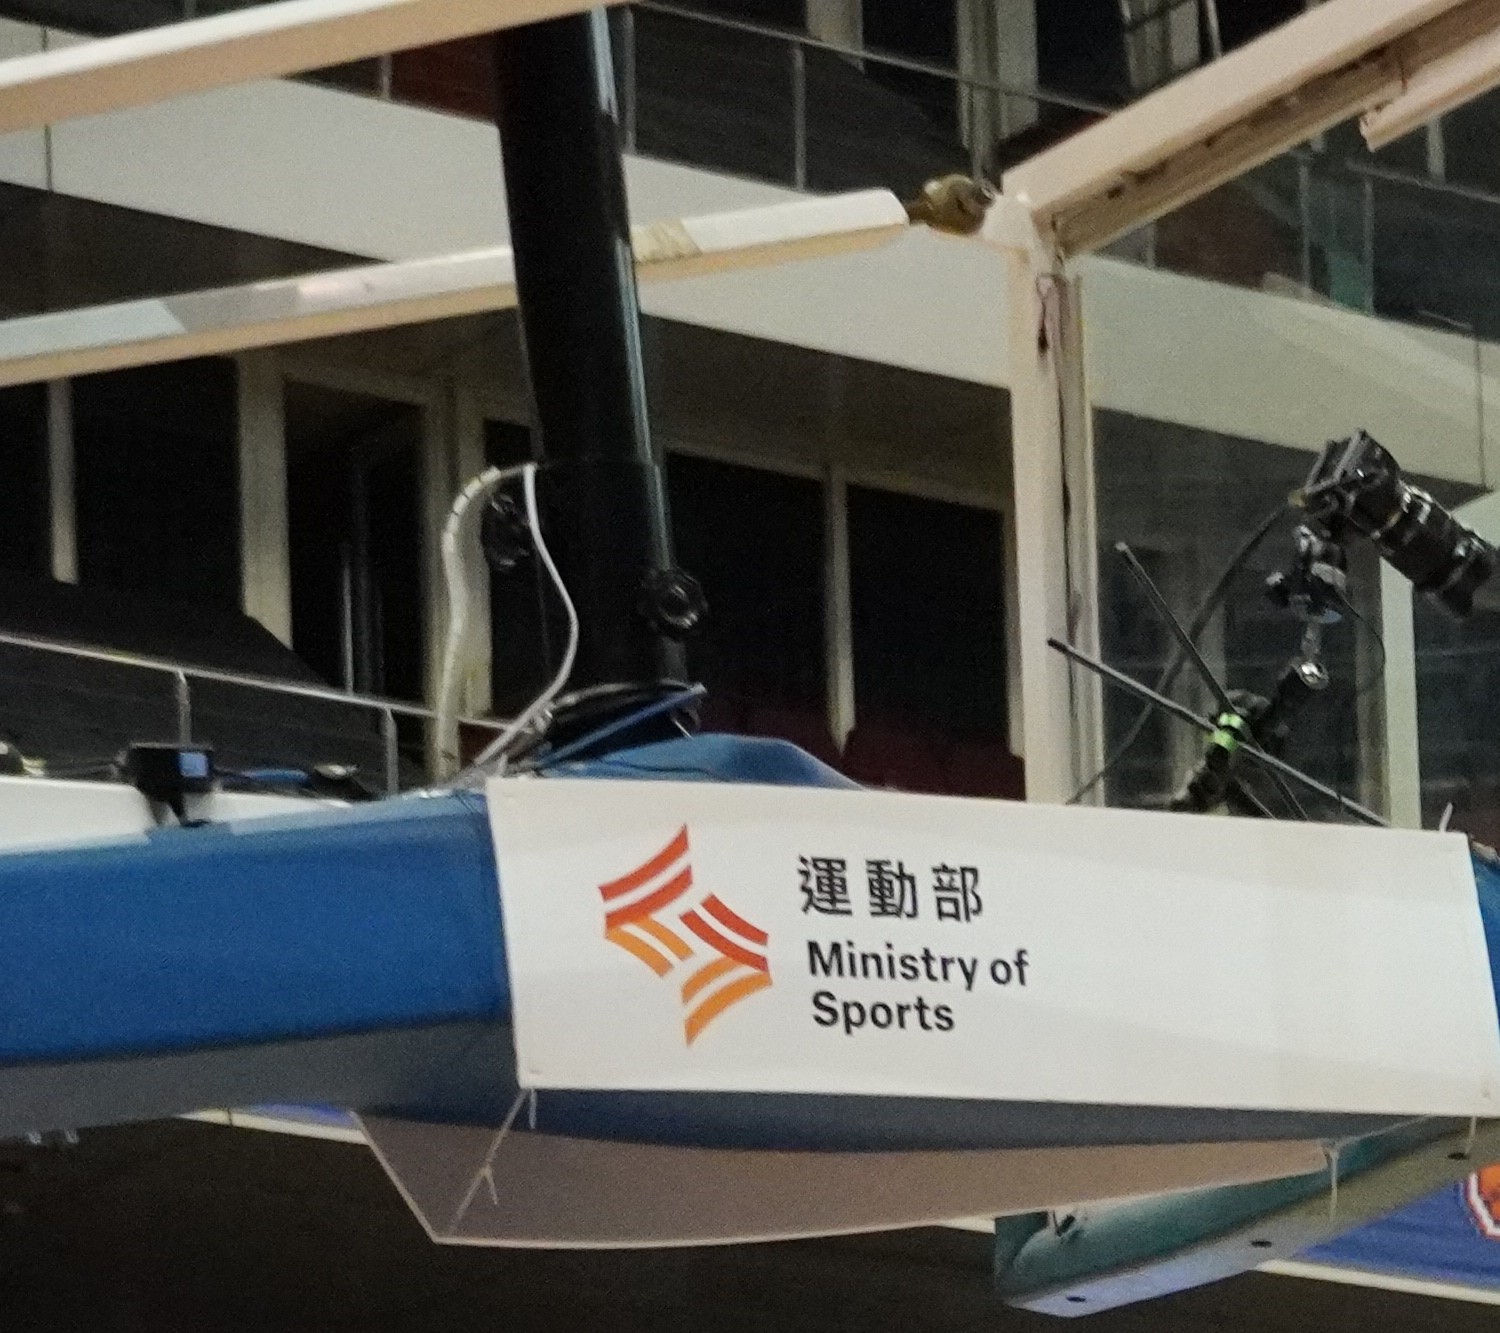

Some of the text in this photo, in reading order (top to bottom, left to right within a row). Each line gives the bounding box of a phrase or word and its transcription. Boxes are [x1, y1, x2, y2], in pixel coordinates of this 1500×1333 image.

[798, 853, 984, 924] 運動部
[807, 939, 1030, 992] Ministry of
[811, 990, 955, 1036] Sports
